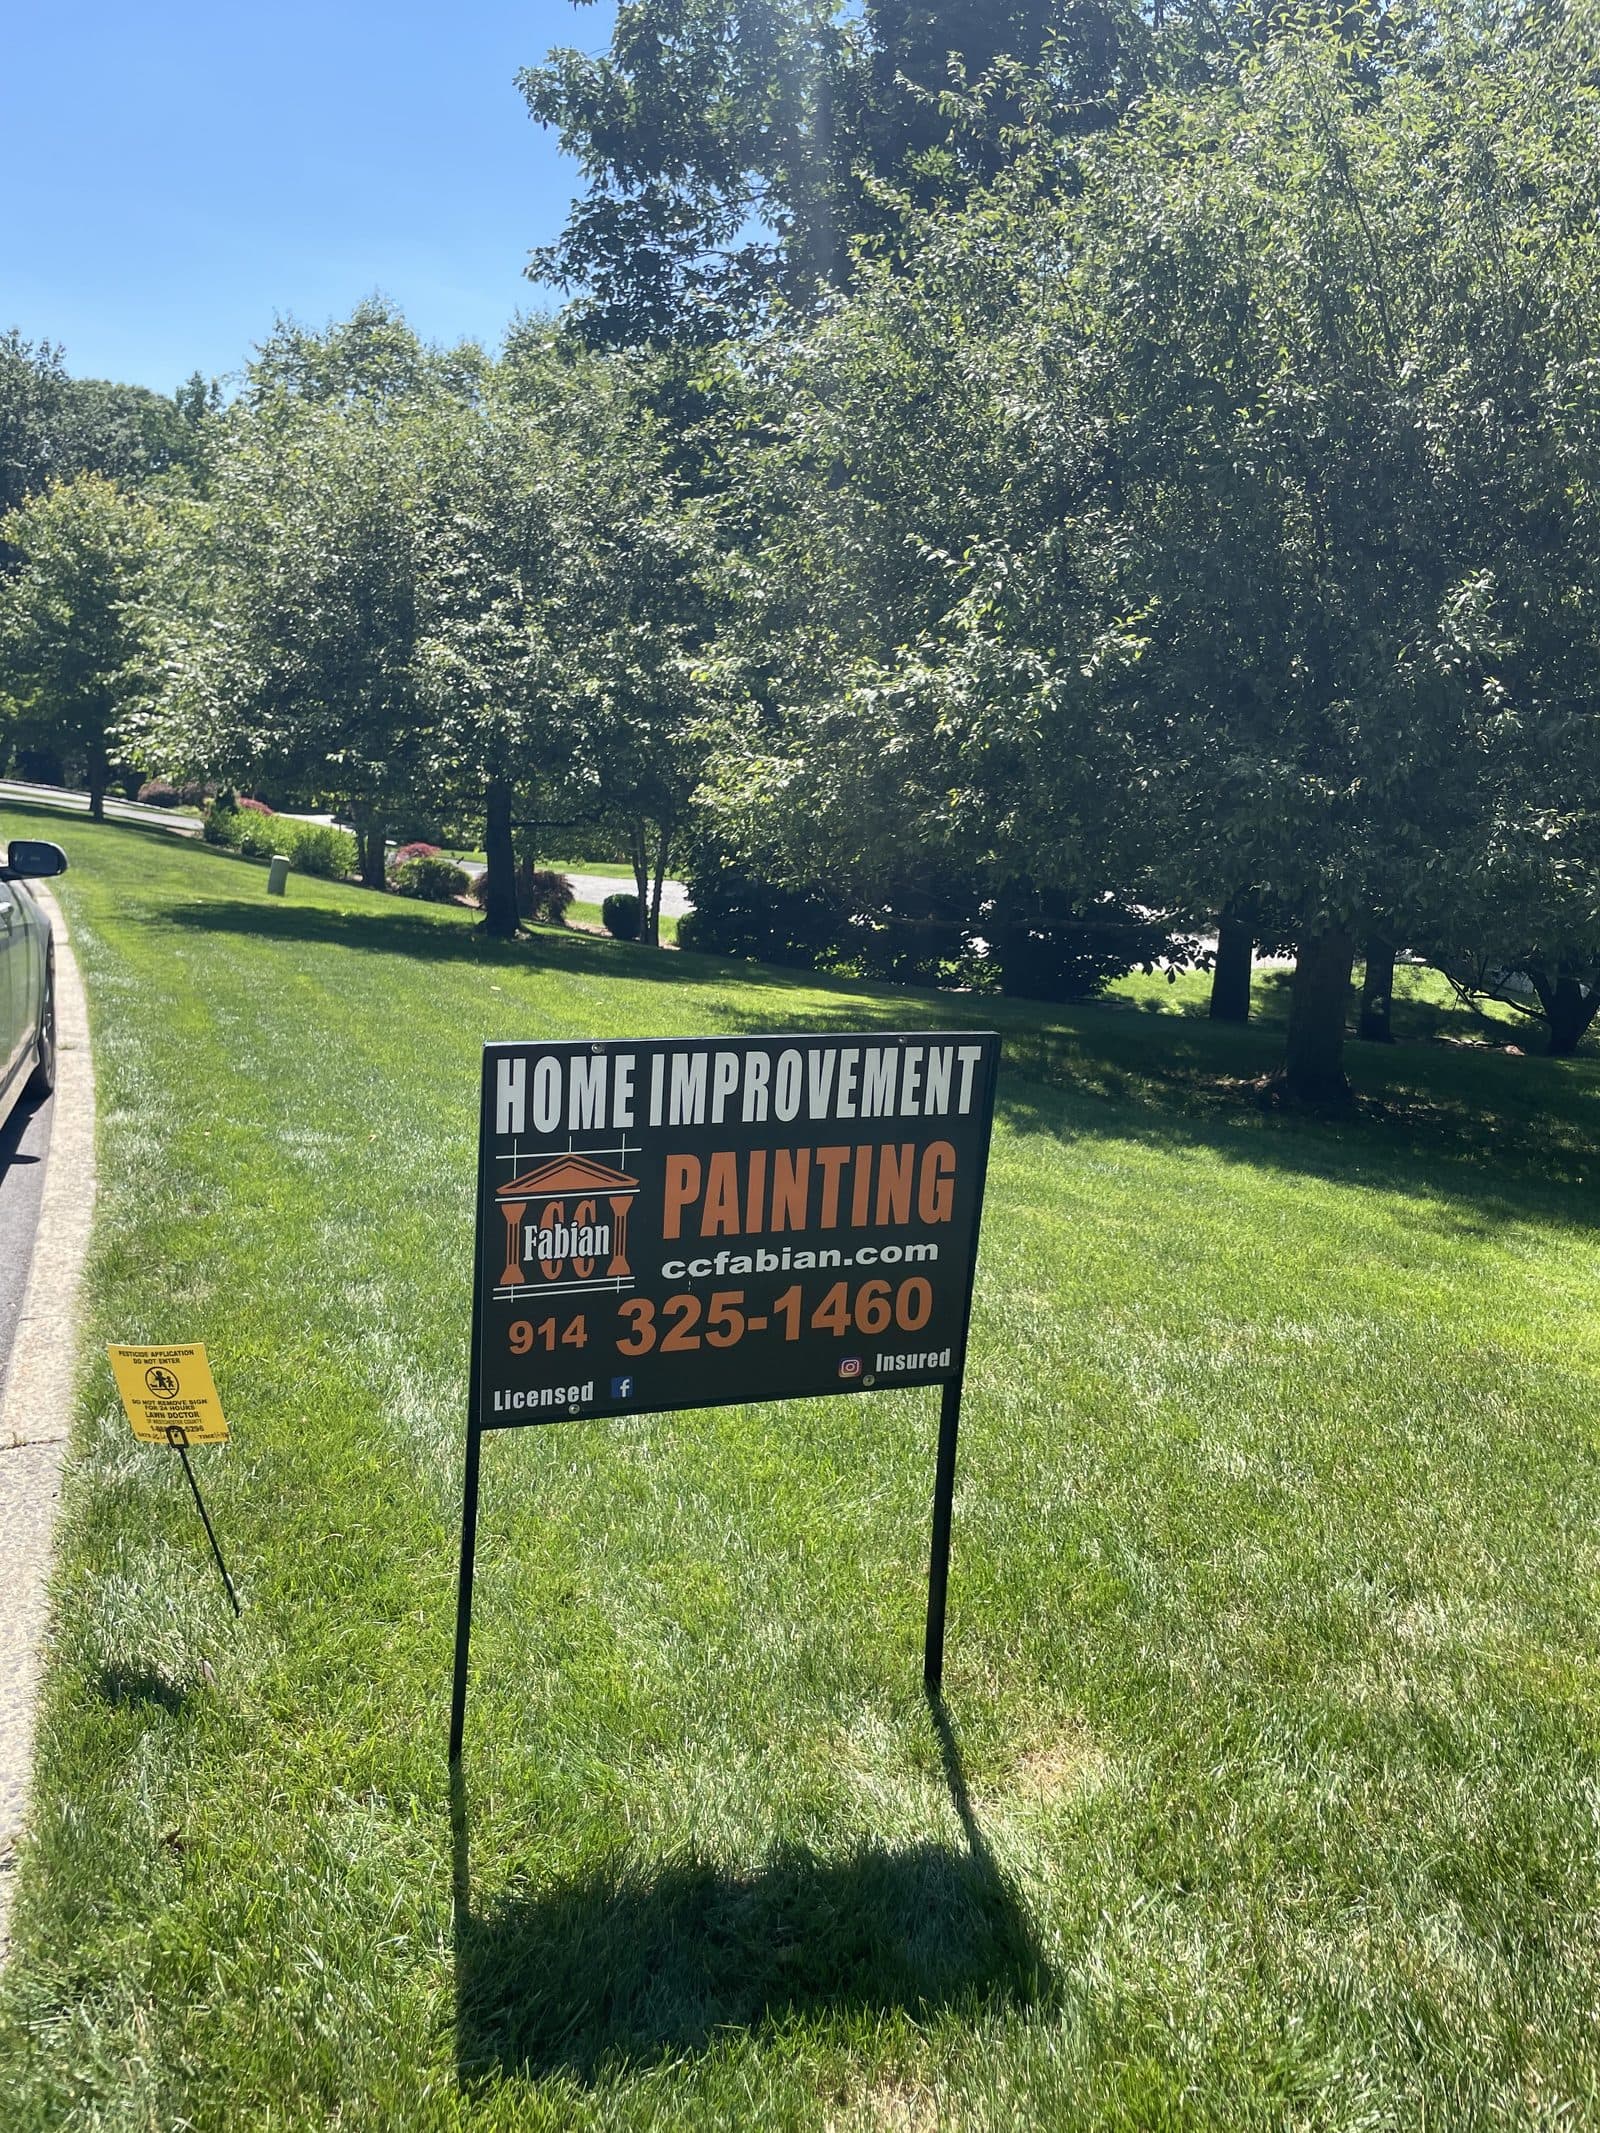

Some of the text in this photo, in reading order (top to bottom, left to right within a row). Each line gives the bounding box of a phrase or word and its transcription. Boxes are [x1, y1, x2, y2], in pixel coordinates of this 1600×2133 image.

[495, 1045, 982, 1135] HOME IMPROVEMENT
[662, 1140, 957, 1240] PAINTING
[523, 1219, 610, 1262] Fabian
[661, 1242, 940, 1280] ccfabian.com
[508, 1276, 933, 1356] 914 325-1460
[875, 1348, 951, 1373] Insured
[493, 1381, 594, 1412] Licensed
